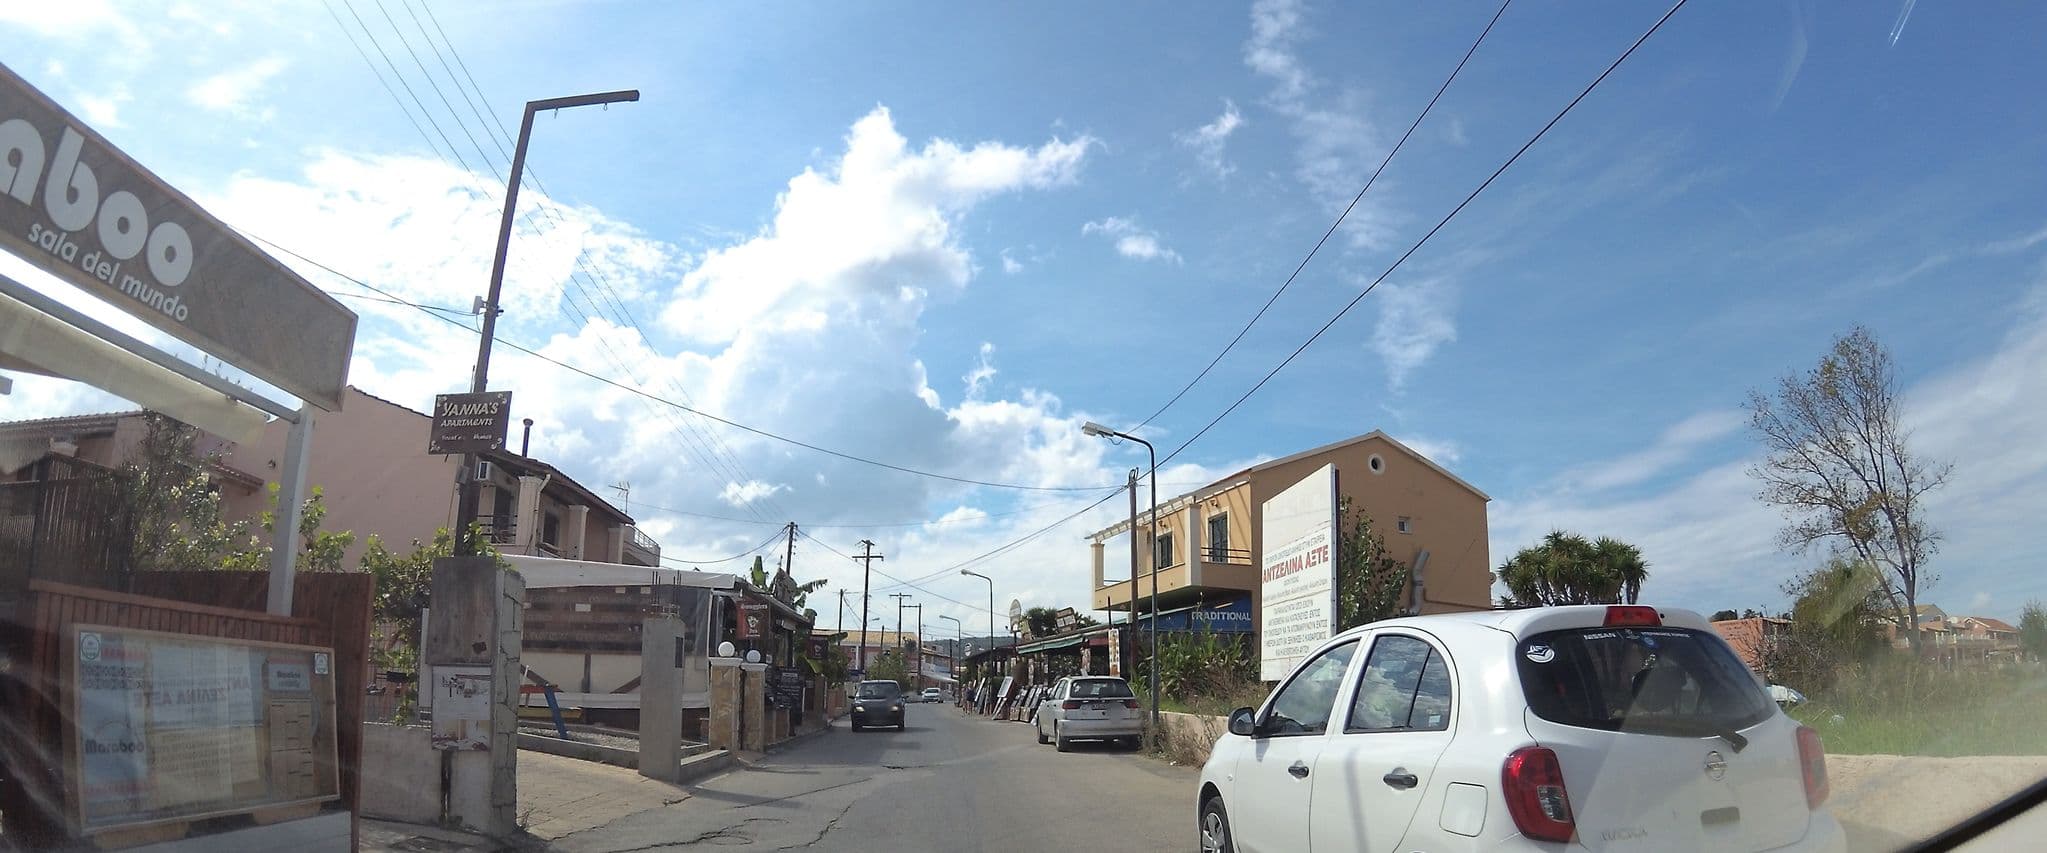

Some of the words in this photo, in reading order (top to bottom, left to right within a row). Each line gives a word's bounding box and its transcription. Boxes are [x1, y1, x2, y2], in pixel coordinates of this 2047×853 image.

[28, 222, 78, 261] sala
[82, 251, 120, 284] del
[121, 271, 188, 322] mundo
[442, 402, 499, 417] YANNA'S
[441, 418, 494, 427] APARTMENTS
[1305, 545, 1329, 569] ΑΞΤΕ
[1191, 611, 1252, 621] TRADITIONAL
[1583, 632, 1616, 640] NISSAN
